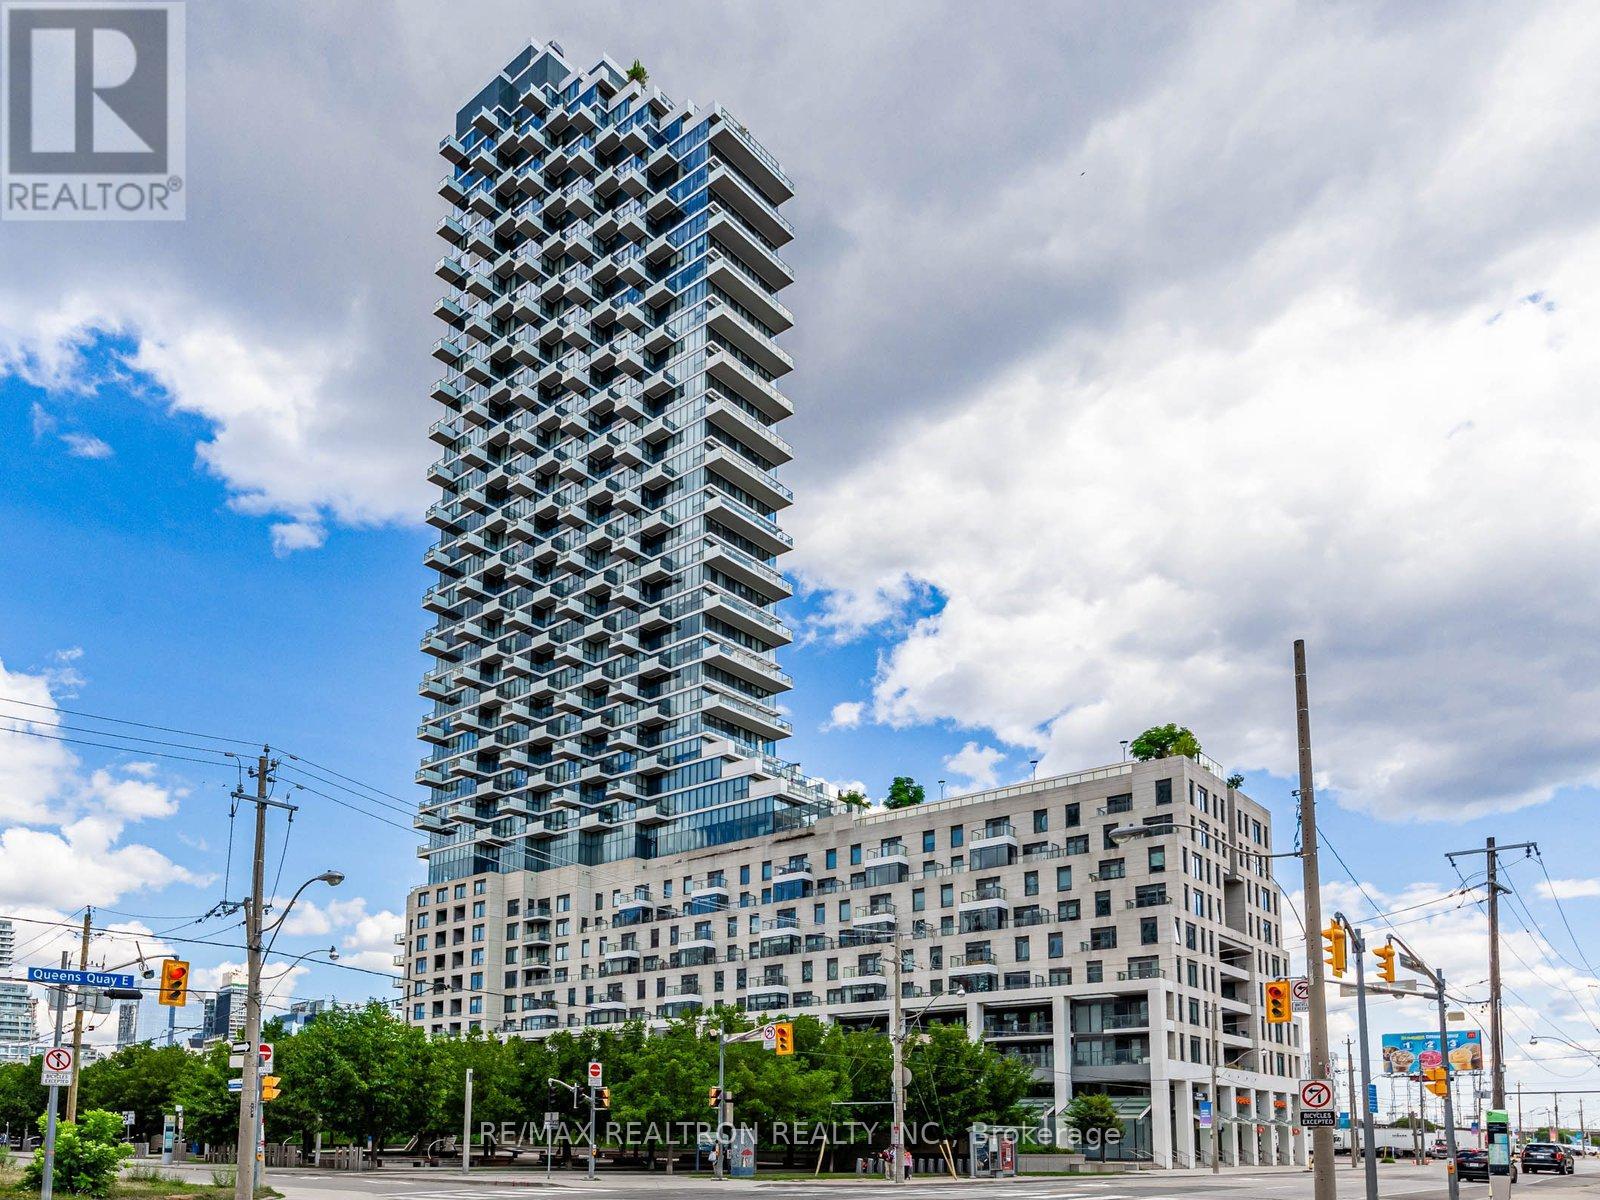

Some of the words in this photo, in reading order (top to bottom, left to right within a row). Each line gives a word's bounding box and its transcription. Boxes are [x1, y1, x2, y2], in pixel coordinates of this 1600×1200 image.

[33, 969, 81, 982] Queens
[86, 973, 117, 986] Quay
[122, 976, 129, 986] E
